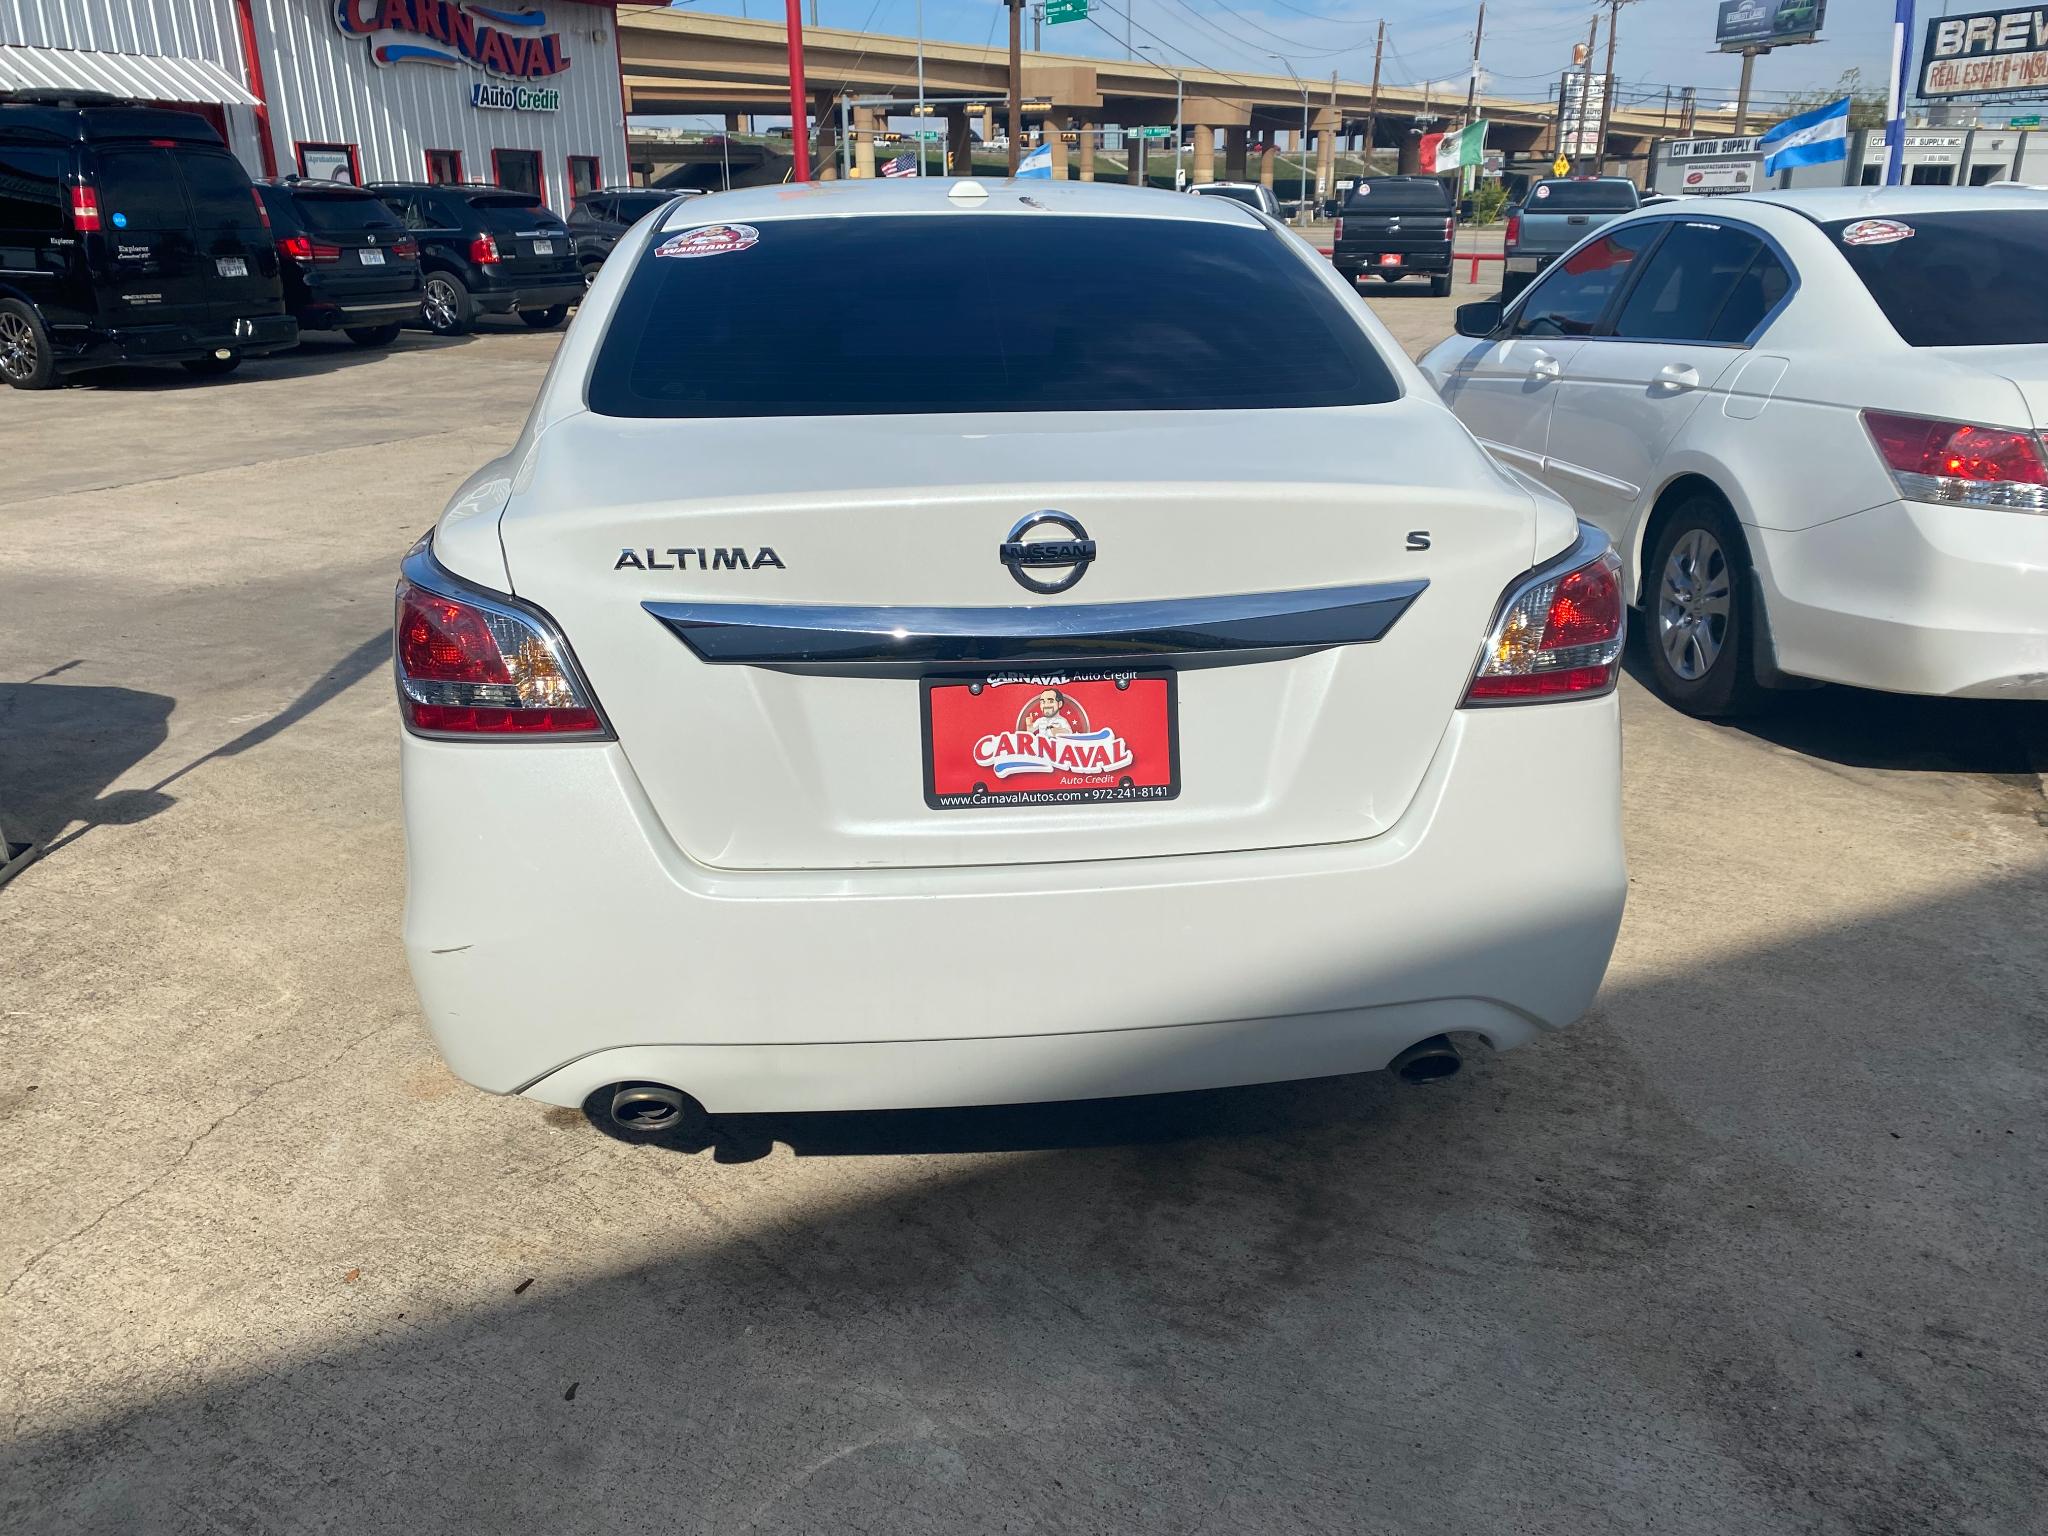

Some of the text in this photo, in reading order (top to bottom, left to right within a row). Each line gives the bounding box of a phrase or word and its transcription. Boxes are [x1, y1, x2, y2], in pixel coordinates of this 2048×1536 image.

[338, 0, 571, 77] CARNAVAL
[1930, 64, 1960, 88] REAL
[1964, 59, 2010, 85] ESTATE
[480, 87, 559, 110] Auto Credit
[1674, 143, 1690, 156] CITY
[1694, 140, 1717, 154] MOTOR
[118, 245, 149, 253] Explorer
[662, 242, 745, 255] WARRANTY
[1406, 530, 1431, 551] S
[613, 547, 786, 571] ALTIMA
[1010, 544, 1087, 559] NISSAN
[986, 670, 1137, 686] CARNAVAL Auto Credit
[974, 731, 1131, 769] CARNAVAL
[1060, 774, 1114, 785] Auto Credit
[940, 786, 1168, 806] www.CarnavalAutos.com 972-241-8141
